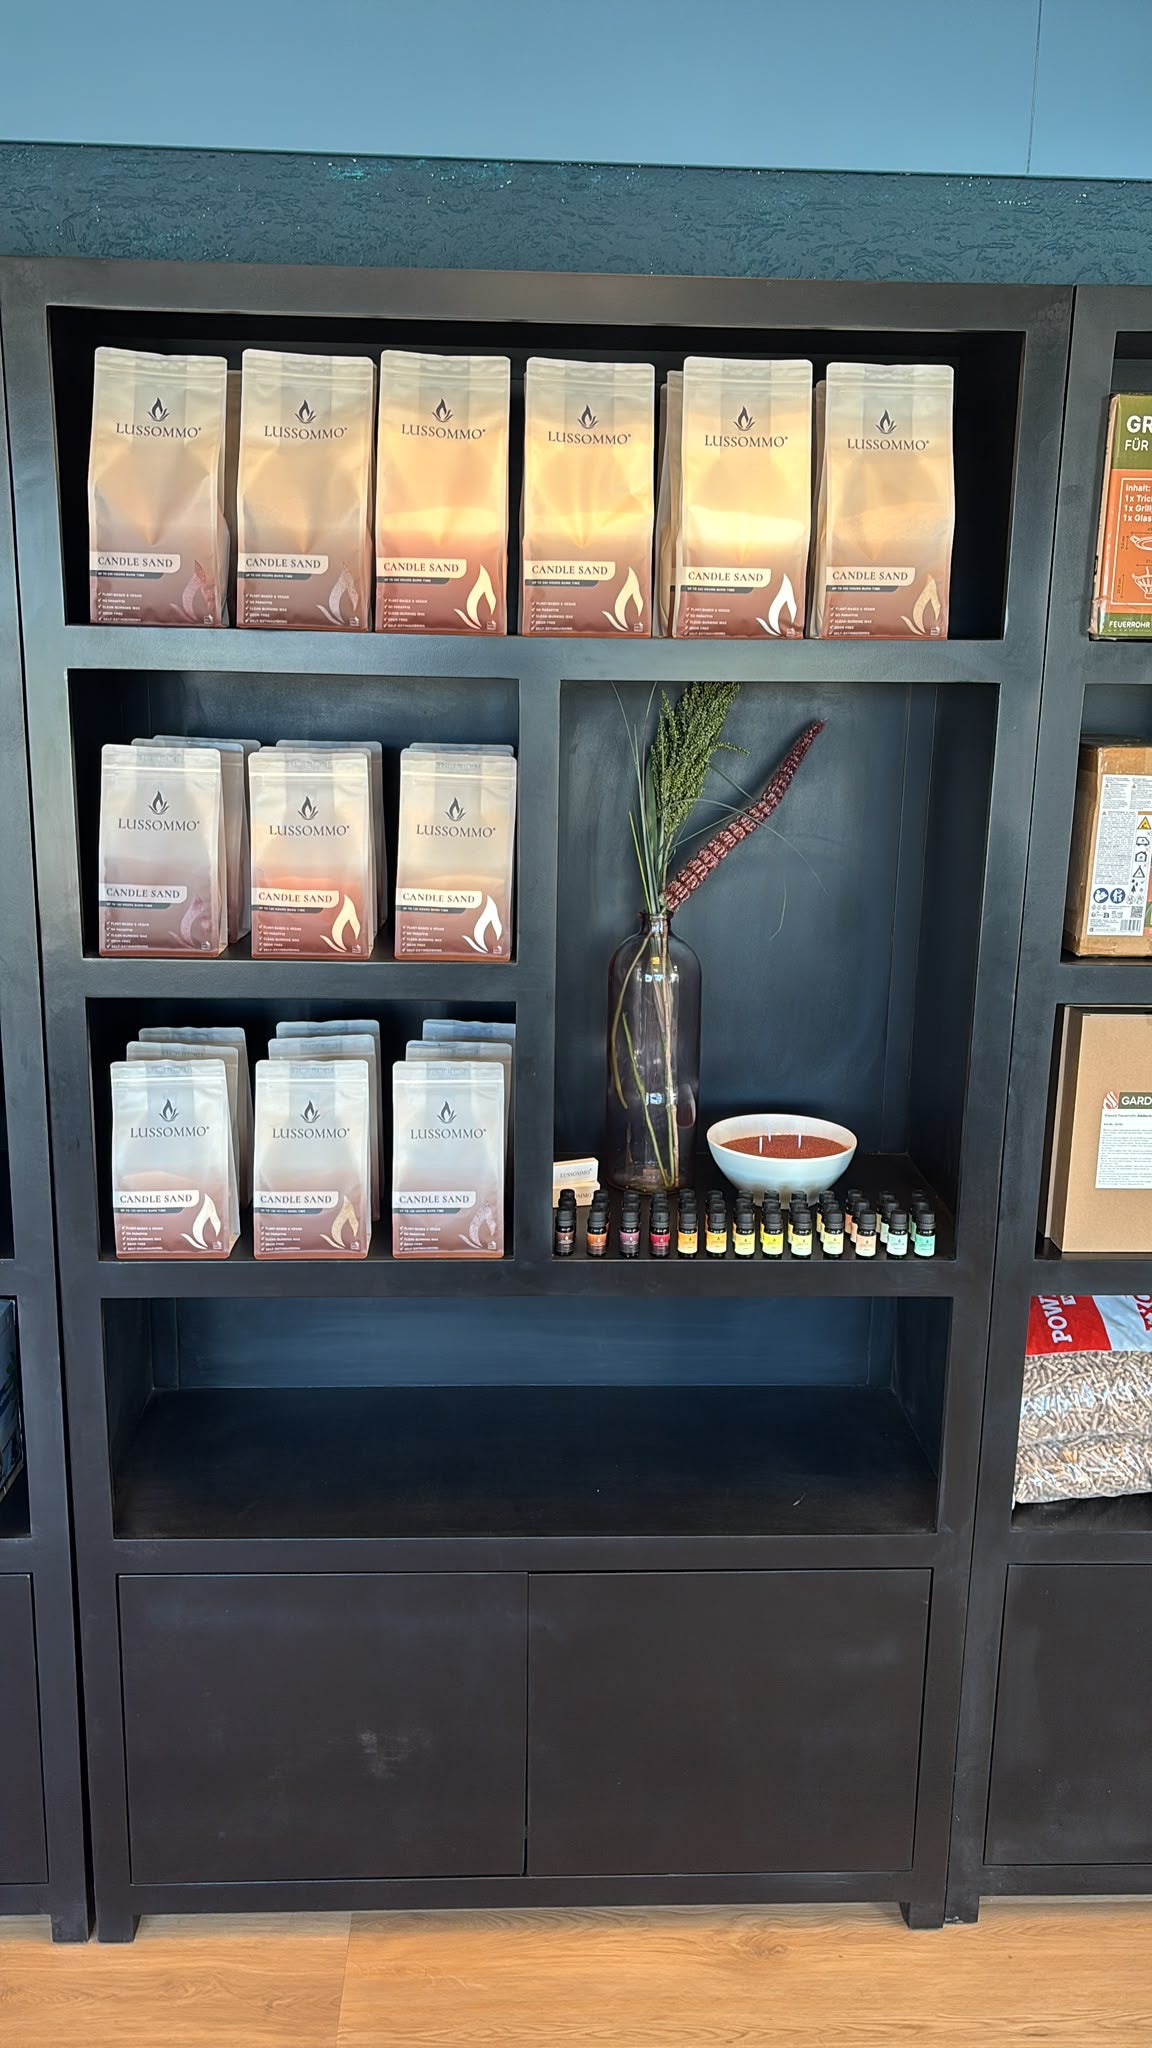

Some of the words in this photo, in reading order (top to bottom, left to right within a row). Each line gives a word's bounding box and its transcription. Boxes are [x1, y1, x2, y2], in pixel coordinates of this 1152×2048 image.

[1124, 438, 1148, 451] FÜR
[1126, 484, 1150, 492] Inhalt:
[1136, 504, 1152, 512] Grill
[98, 556, 139, 568] CANDLE
[142, 558, 173, 568] SAND
[246, 557, 287, 568] CANDLE
[290, 558, 321, 569] SAND
[384, 562, 425, 572] CANDLE
[429, 563, 460, 573] SAND
[532, 565, 575, 575] CANDLE
[578, 566, 608, 576] SAND
[688, 572, 730, 582] CANDLE
[734, 572, 764, 582] SAND
[832, 572, 875, 582] CANDLE
[878, 572, 908, 582] SAND
[1109, 620, 1150, 628] FEUERROHR
[106, 888, 148, 898] CANDLE
[151, 889, 180, 898] SAND
[258, 893, 300, 902] CANDLE
[303, 894, 332, 903] SAND
[402, 893, 444, 902] CANDLE
[448, 894, 475, 903] SAND
[1121, 1096, 1152, 1106] GARD
[120, 1194, 161, 1204] CANDLE
[164, 1194, 192, 1203] SAND
[260, 1196, 301, 1204] CANDLE
[304, 1196, 332, 1204] SAND
[399, 1196, 440, 1204] CANDLE
[442, 1196, 470, 1204] SAND
[1038, 1296, 1073, 1344] POW
